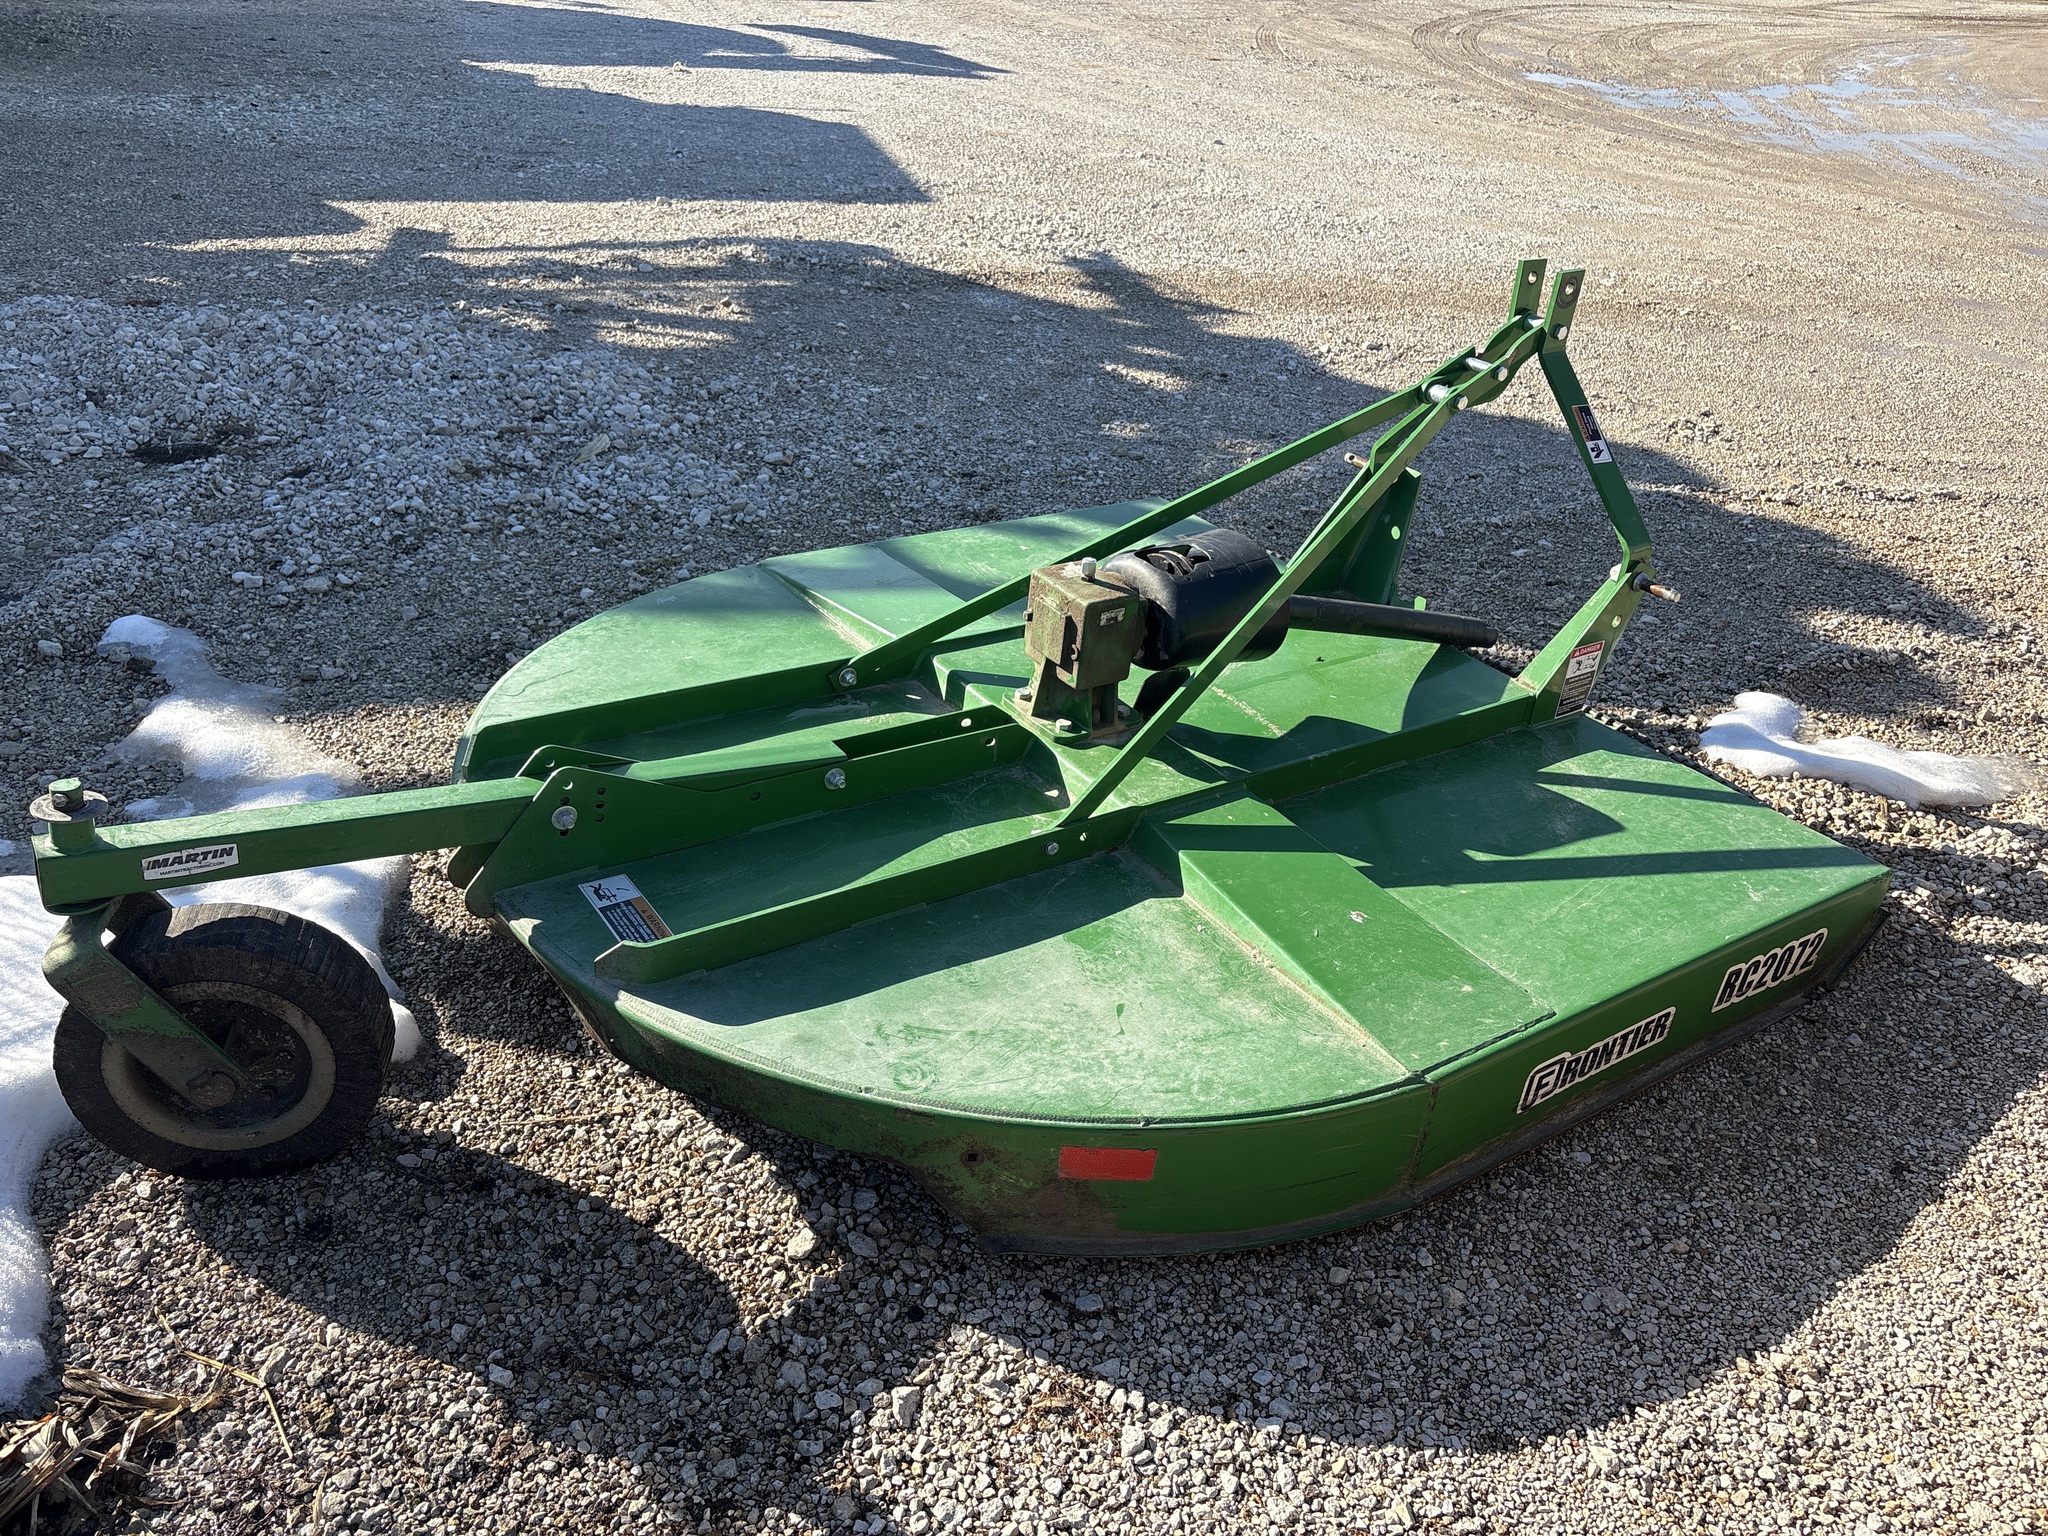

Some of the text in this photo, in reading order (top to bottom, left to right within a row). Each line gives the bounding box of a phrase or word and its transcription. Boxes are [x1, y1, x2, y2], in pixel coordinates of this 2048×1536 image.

[1579, 643, 1601, 656] DANGER
[149, 846, 235, 870] MARTIN
[1715, 931, 1825, 1008] RC2072
[1519, 1010, 1673, 1112] FRONTIER
